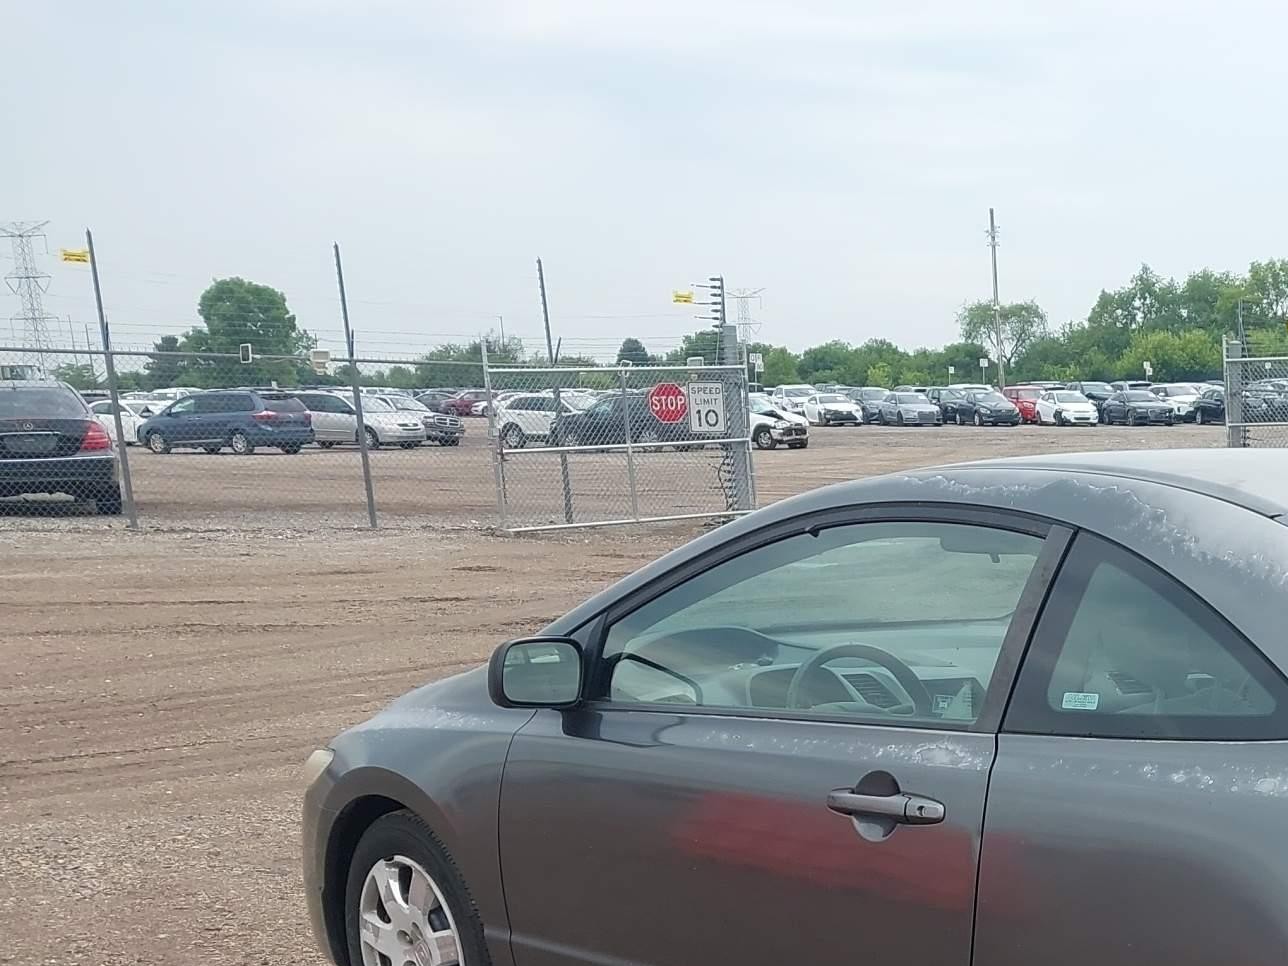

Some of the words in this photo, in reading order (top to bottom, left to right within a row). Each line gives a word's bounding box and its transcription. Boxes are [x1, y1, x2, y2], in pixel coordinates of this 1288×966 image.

[691, 387, 721, 395] SPEED
[651, 396, 685, 411] STOP
[696, 409, 719, 427] 10
